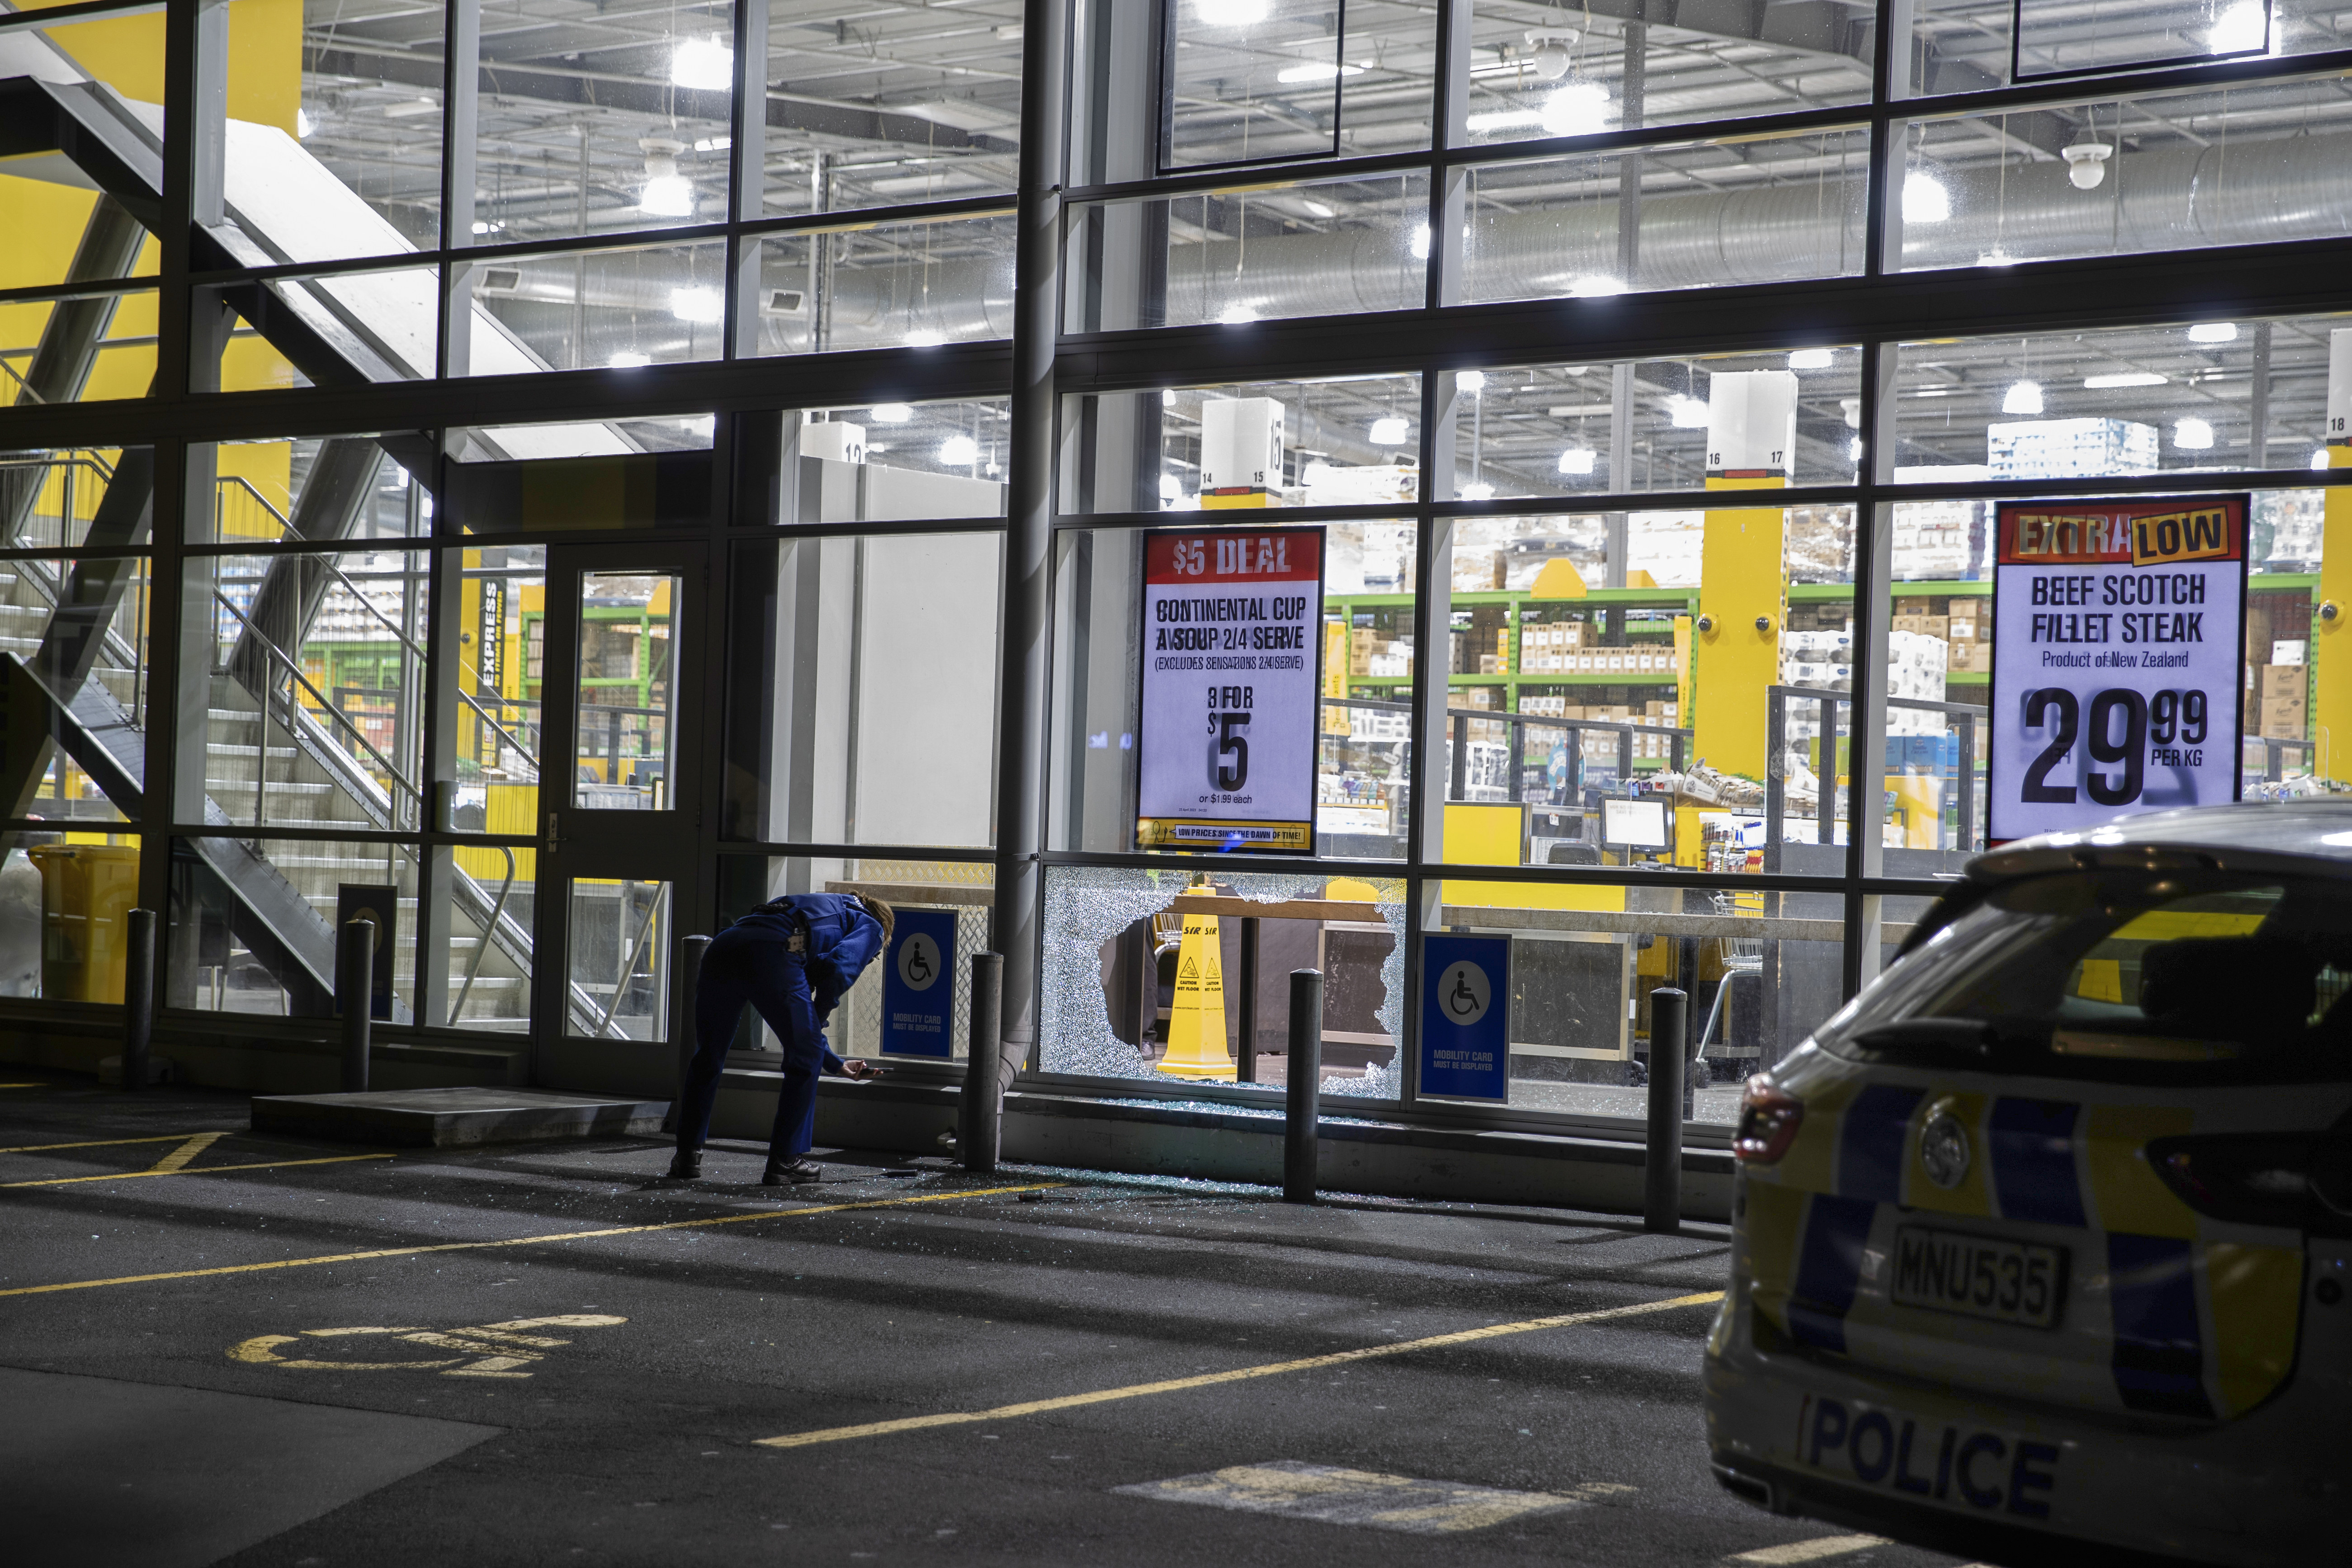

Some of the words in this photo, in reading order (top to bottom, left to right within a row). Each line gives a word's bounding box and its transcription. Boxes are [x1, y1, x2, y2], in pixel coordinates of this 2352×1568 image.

[2331, 418, 2344, 431] 18
[1270, 418, 1281, 471] 15
[1710, 453, 1720, 465] 16
[1771, 451, 1783, 463] 17
[1203, 473, 1212, 483] 14
[1254, 472, 1263, 482] 15
[2019, 514, 2131, 554] EXTRA
[2139, 513, 2221, 558] LOW
[1173, 540, 1204, 575] $5
[1217, 537, 1291, 574] DEAL
[2031, 576, 2095, 606] BEEF
[2102, 573, 2206, 606] SCOTCH
[1157, 598, 1267, 622] CONTINENTAL
[1273, 597, 1306, 620] CUP
[483, 582, 497, 686] EXPRESS
[496, 626, 501, 639] OR
[2031, 613, 2113, 642] FILLET
[2121, 612, 2203, 643] STEAK
[1156, 628, 1167, 650] A
[1174, 628, 1218, 650] SOUP
[1223, 627, 1247, 650] 2/4
[1253, 626, 1304, 650] SERVE
[1155, 657, 1203, 672] (EXCLUDES
[1206, 656, 1256, 670] SENSATIONS
[1259, 656, 1272, 669] 2/4
[1275, 656, 1303, 671] SERVE)
[2042, 651, 2091, 667] Product
[2095, 651, 2106, 667] of
[2112, 651, 2137, 667] New
[2142, 651, 2188, 667] Zealand
[1208, 687, 1217, 708] 3
[1222, 686, 1253, 708] FOR
[2151, 749, 2180, 766] PER
[2184, 749, 2202, 766] KG
[1210, 793, 1232, 804] $1.99
[1233, 795, 1252, 804] each
[1191, 829, 1217, 837] PRICES
[1251, 831, 1270, 839] DAWN
[1282, 831, 1300, 840] TIME!
[893, 1013, 922, 1023] MOBILITY
[924, 1015, 941, 1024] CARD
[1434, 1049, 1469, 1060] MOBILITY
[1472, 1052, 1492, 1062] CARD
[1461, 1063, 1492, 1071] DISPLAYED
[1900, 1238, 2049, 1316] MNU535
[1810, 1397, 2060, 1520] POLICE
